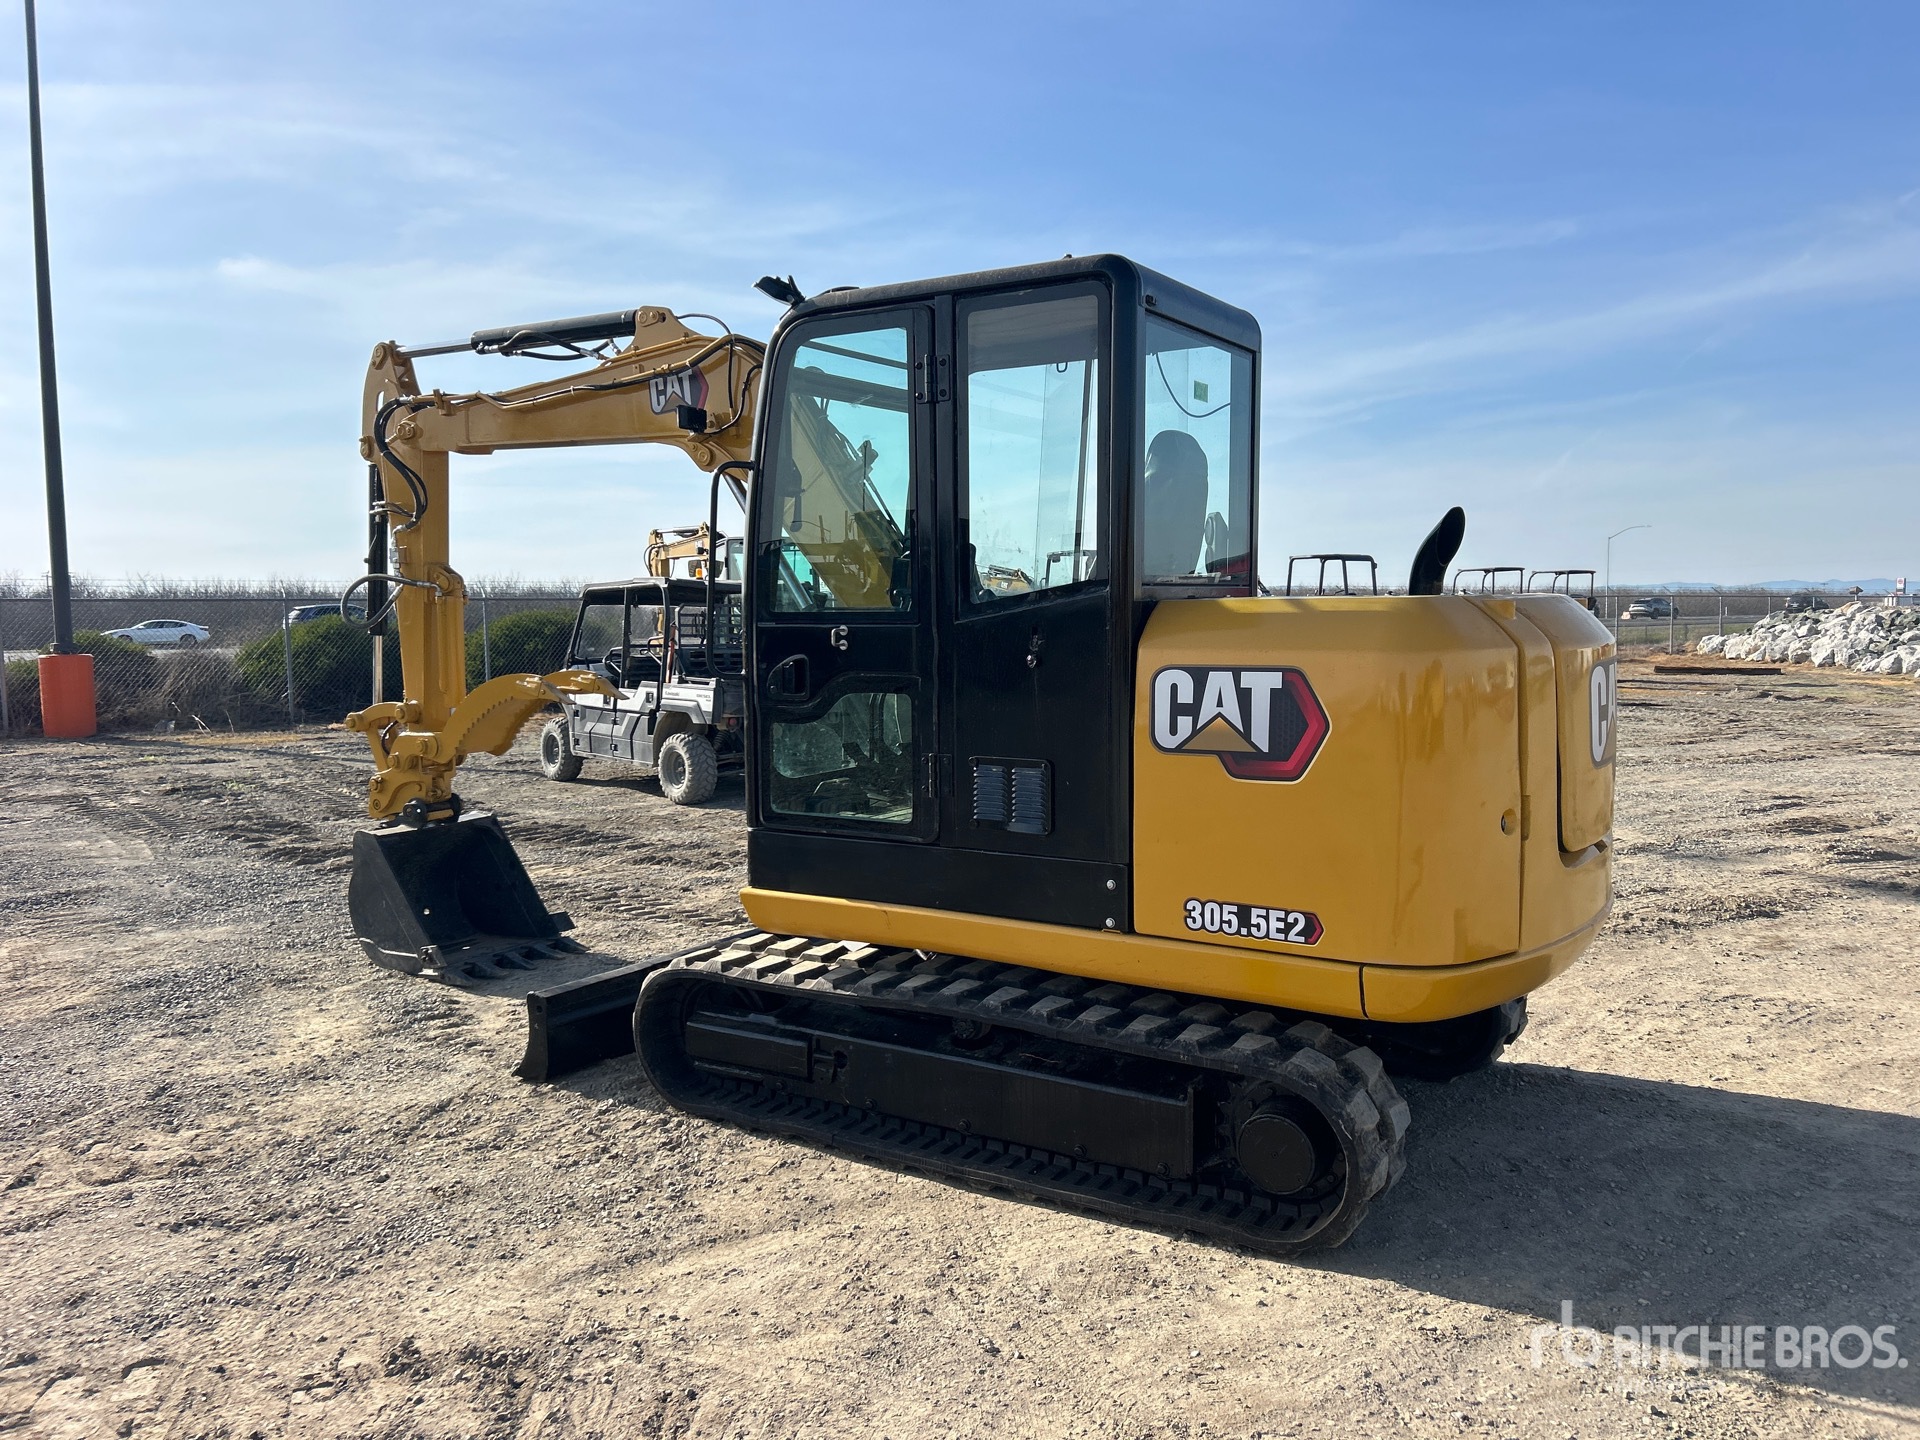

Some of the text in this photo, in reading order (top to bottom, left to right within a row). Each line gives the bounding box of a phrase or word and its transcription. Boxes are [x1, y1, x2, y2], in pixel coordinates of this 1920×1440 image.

[650, 369, 693, 412] CAT
[1154, 669, 1283, 753] CAT
[1591, 662, 1617, 762] CA
[1186, 899, 1306, 943] 305.5E2
